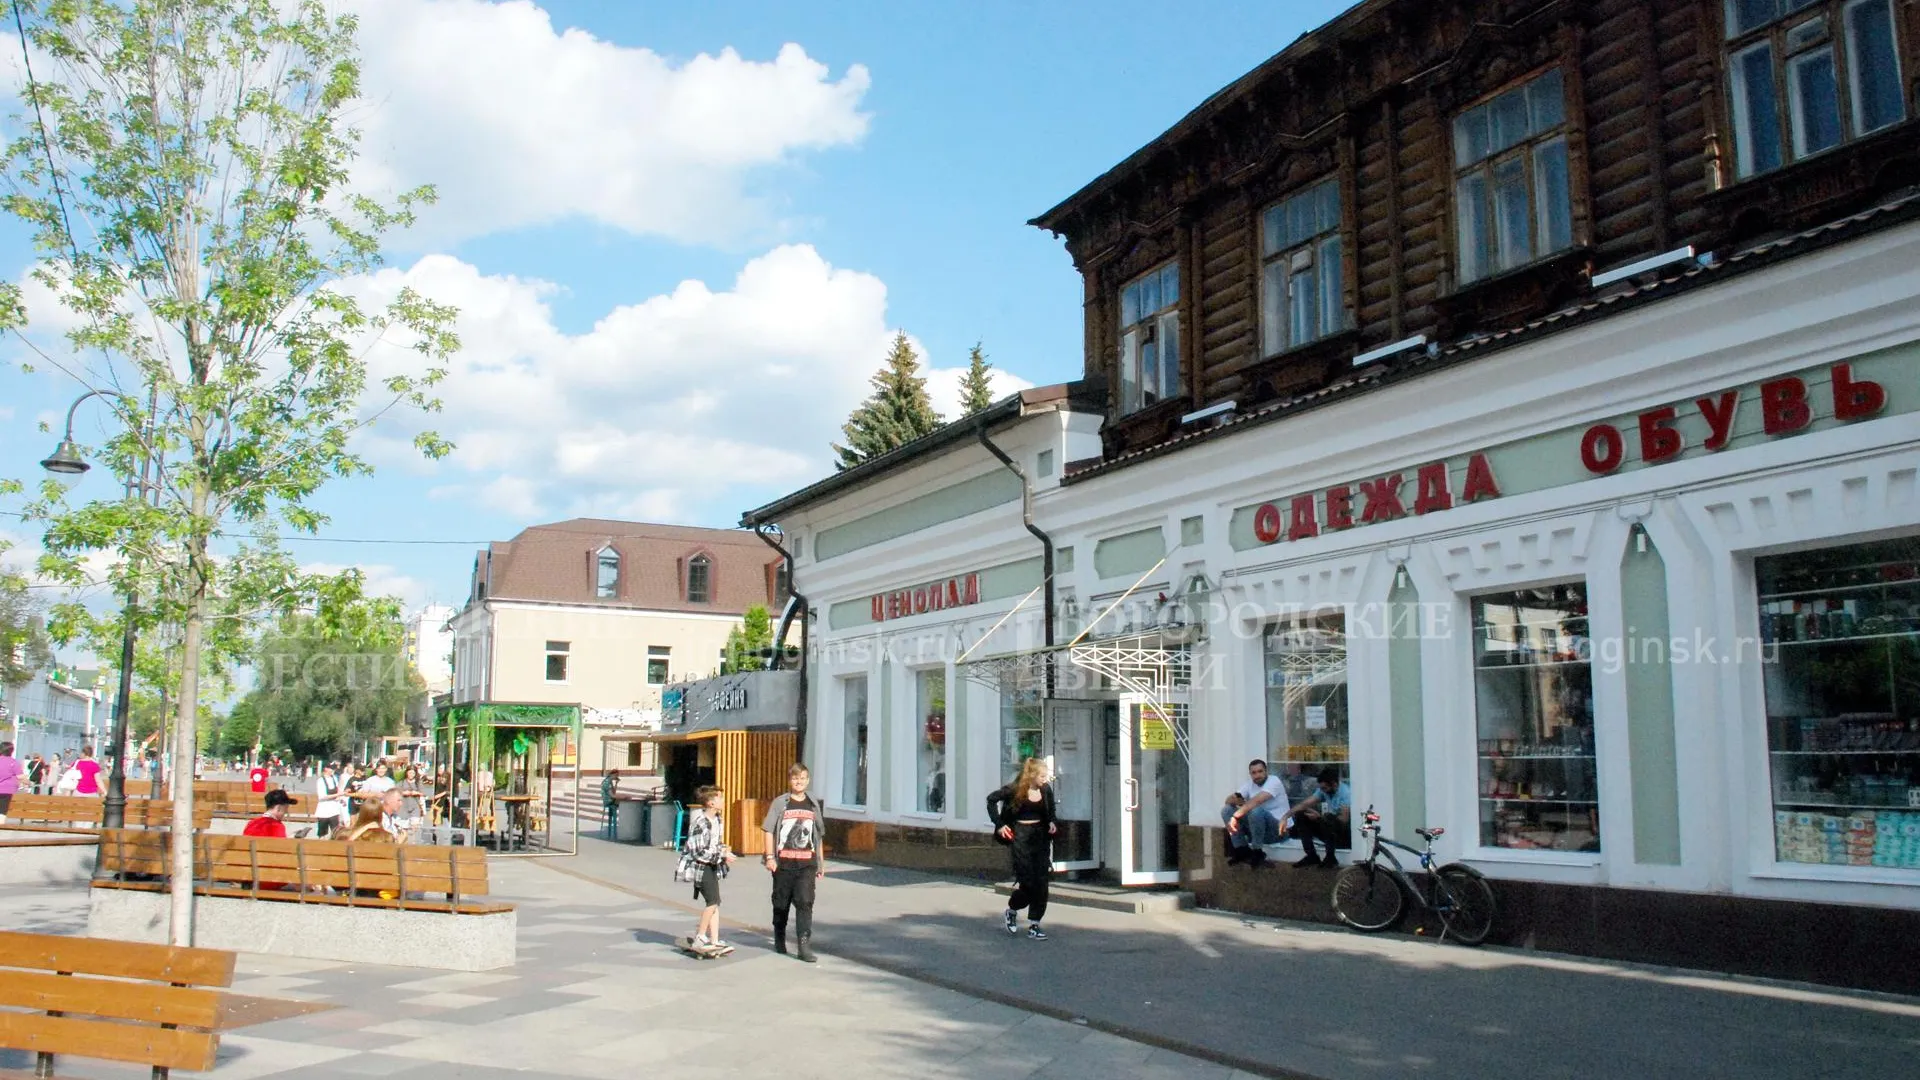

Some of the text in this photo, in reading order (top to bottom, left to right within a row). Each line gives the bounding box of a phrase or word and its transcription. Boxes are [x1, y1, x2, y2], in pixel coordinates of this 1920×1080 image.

[1253, 362, 1887, 544] ОДЕЖДА ОБУВЬ
[871, 573, 982, 623] ЦЕНОПАД
